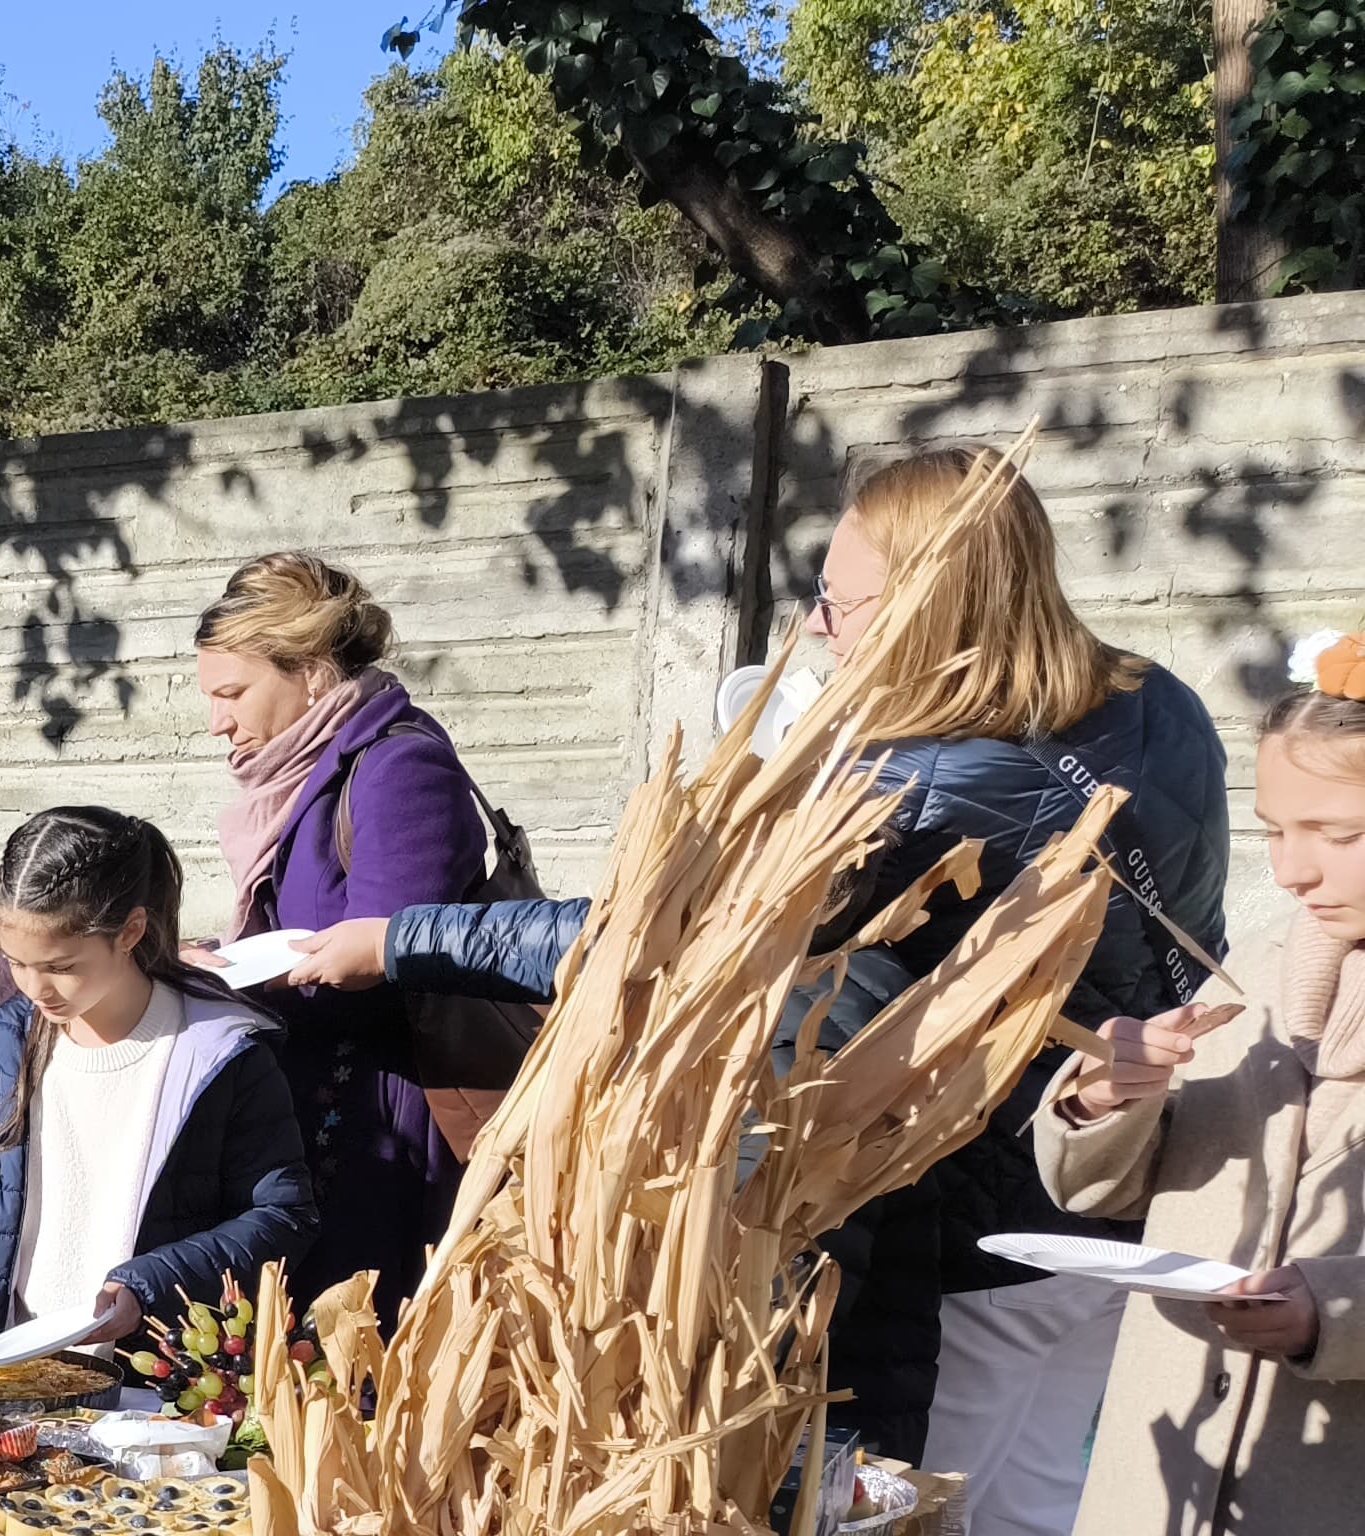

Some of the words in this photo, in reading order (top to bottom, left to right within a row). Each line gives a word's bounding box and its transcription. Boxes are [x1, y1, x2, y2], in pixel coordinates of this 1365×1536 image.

[1059, 755, 1100, 798] GUE
[1128, 848, 1163, 918] GUESS
[1166, 947, 1194, 1005] GUES
